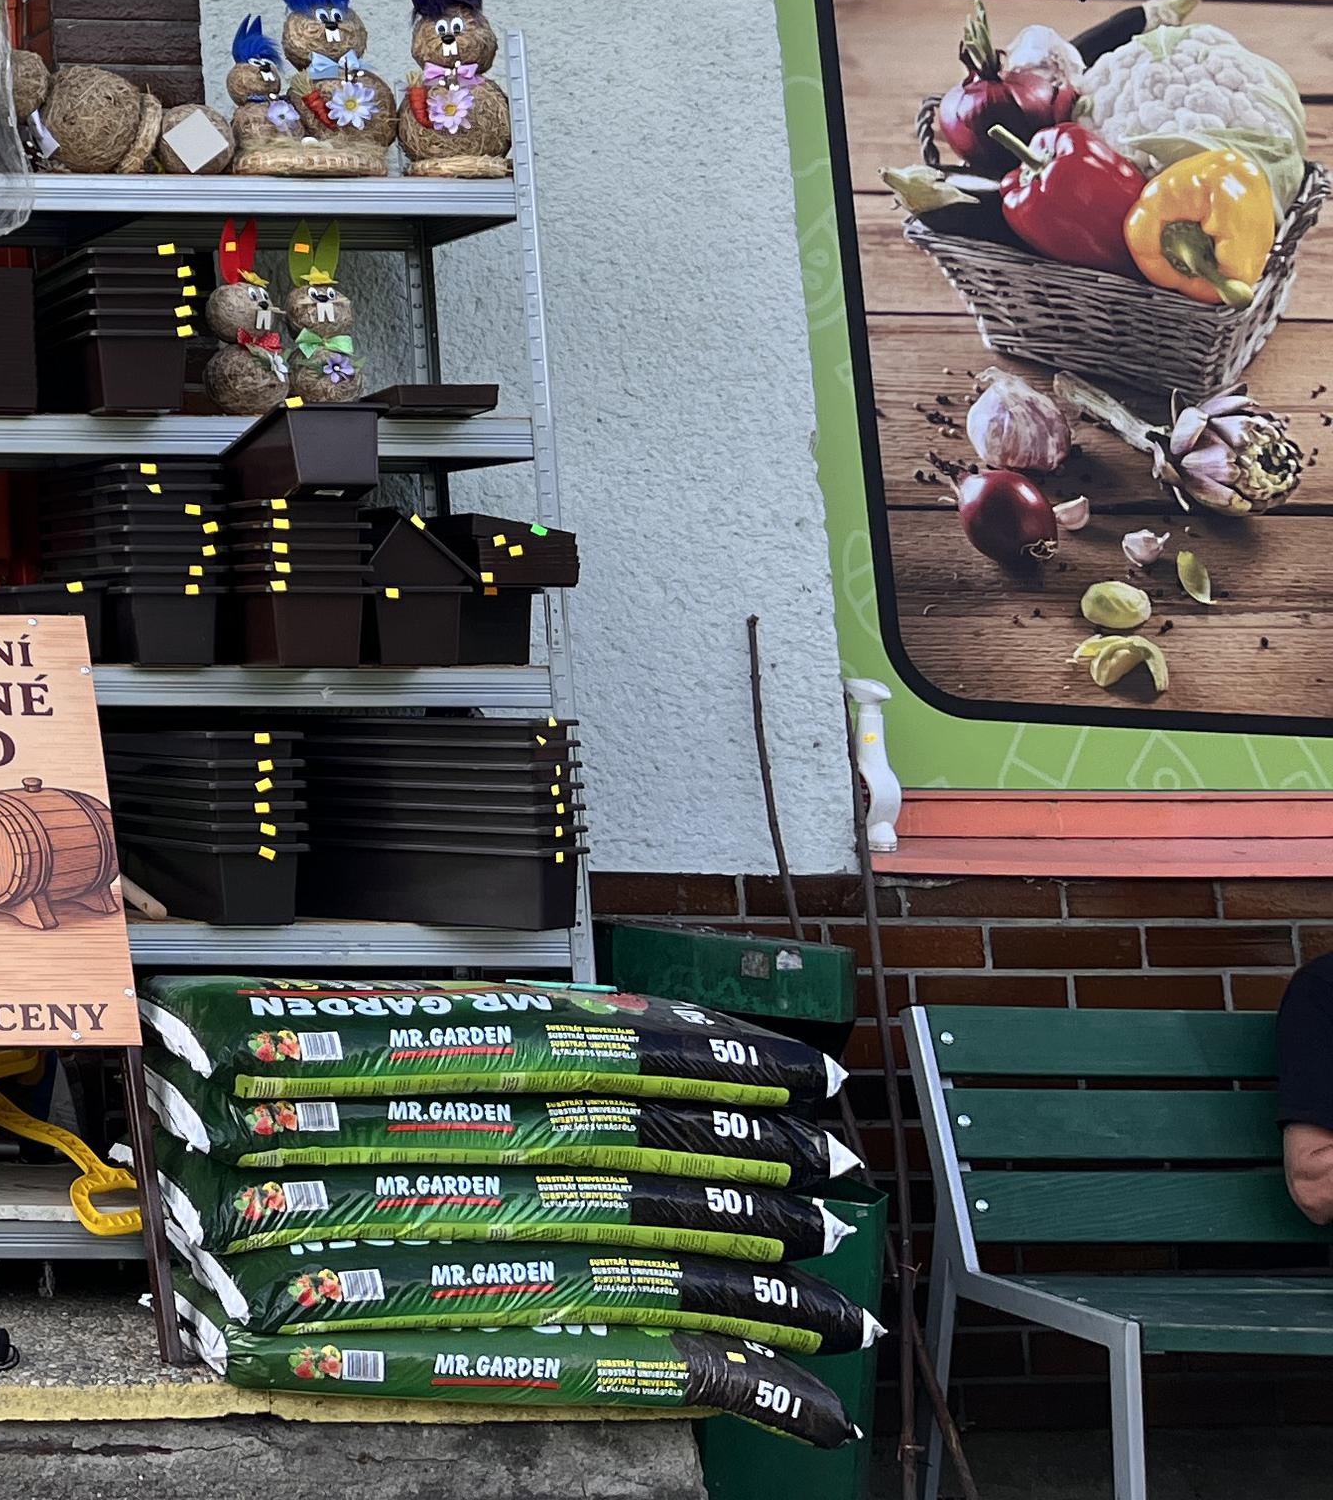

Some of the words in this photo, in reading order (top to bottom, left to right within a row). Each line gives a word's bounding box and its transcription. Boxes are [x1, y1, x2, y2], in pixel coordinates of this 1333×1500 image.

[389, 1026, 512, 1048] MR.GARDEN
[709, 1038, 746, 1064] 50
[387, 1101, 511, 1122] MR.GARDEN
[713, 1111, 748, 1139] 50
[375, 1175, 500, 1196] MR.GARDEN
[704, 1187, 741, 1215] 50
[431, 1260, 555, 1286] MR.GARDEN
[753, 1276, 787, 1306] 50
[434, 1353, 561, 1379] MR.GARDEN
[755, 1380, 790, 1414] 50
